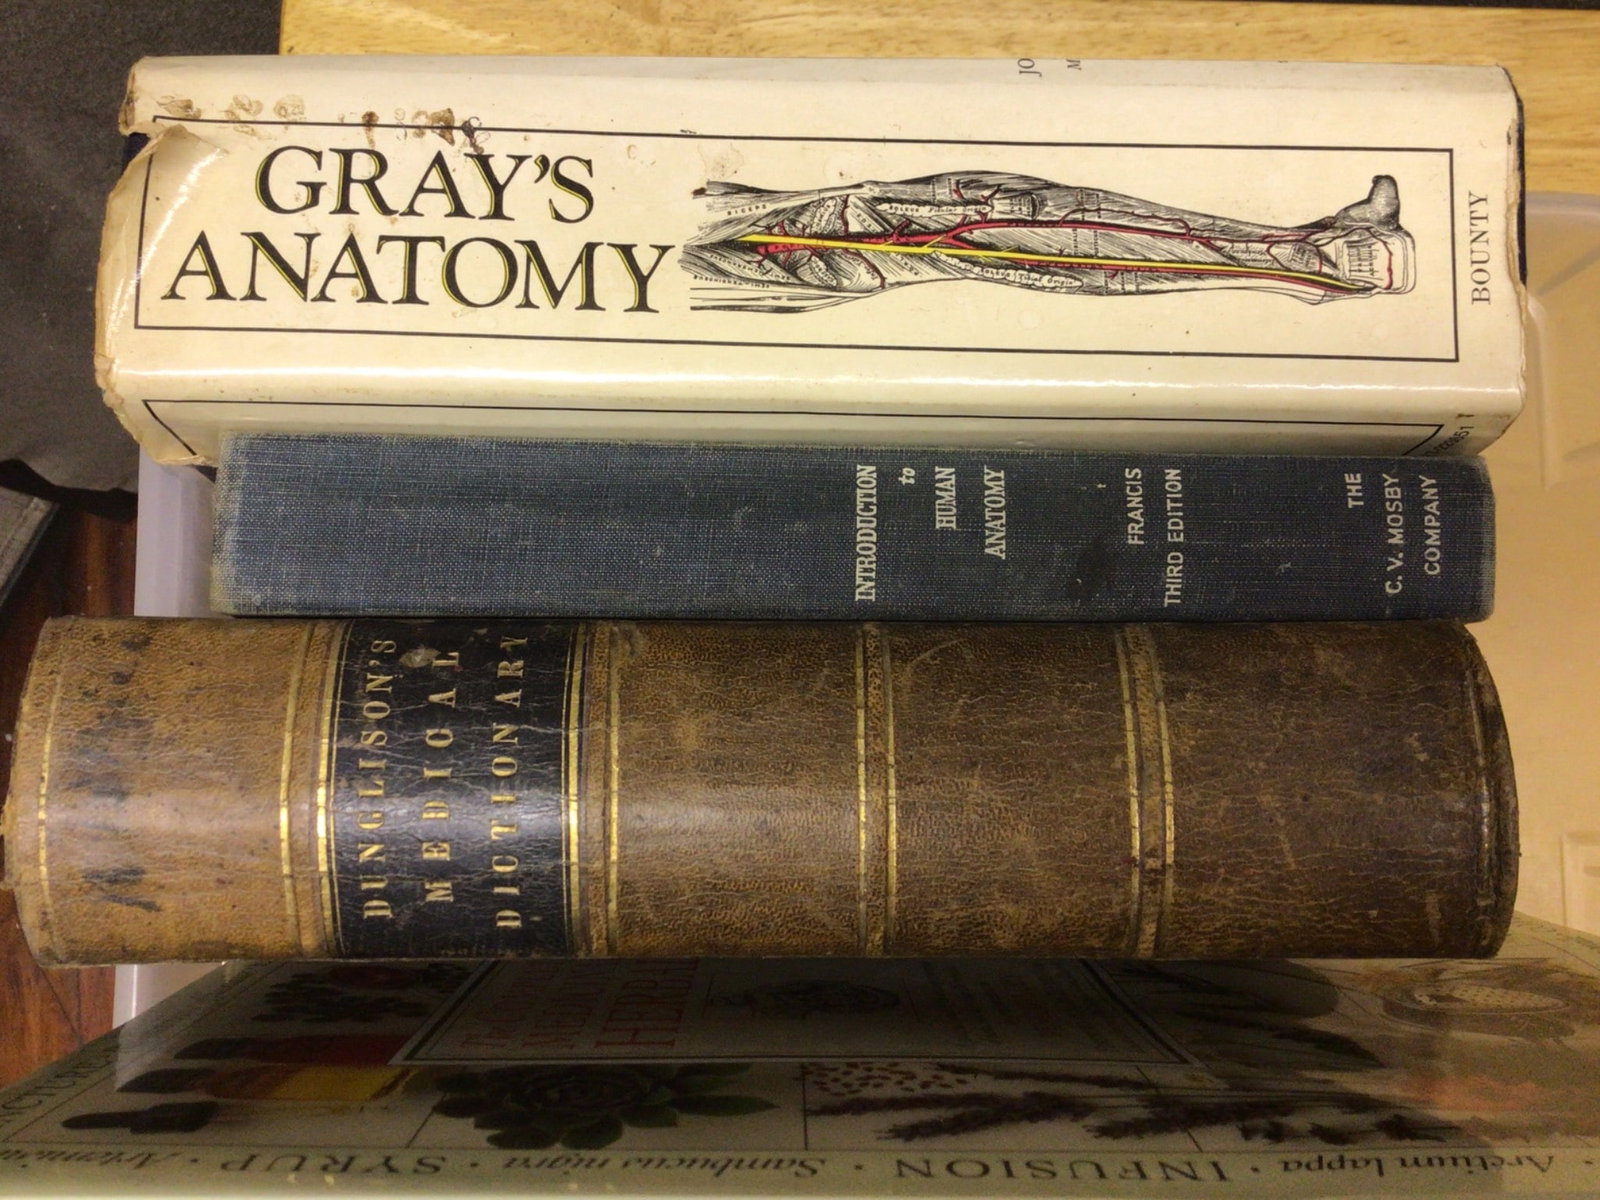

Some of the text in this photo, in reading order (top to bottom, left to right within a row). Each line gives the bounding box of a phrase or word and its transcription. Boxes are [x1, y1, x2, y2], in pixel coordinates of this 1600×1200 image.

[255, 145, 594, 223] GRAY'S
[727, 203, 767, 216] BICEPS
[160, 230, 675, 313] ANATOMY
[1469, 190, 1491, 305] BOUNTY
[898, 467, 916, 486] to
[935, 466, 957, 530] HUMAN
[984, 464, 1006, 560] ANATOMY
[1125, 468, 1145, 545] FRANCIS
[1344, 473, 1364, 508] THE
[1382, 473, 1404, 544] MOSBY
[855, 464, 878, 602] INTRODUCTION
[1164, 469, 1184, 607] THIRD EDITION
[1419, 475, 1441, 575] COMPANY
[358, 639, 397, 919] DUNGLISON'S
[422, 651, 460, 902] MEDICAL
[490, 636, 529, 928] DICTIONARY
[220, 1153, 447, 1175] SYRUP
[895, 1158, 1229, 1182] INFUSION
[1282, 1154, 1385, 1178] lappa
[1400, 1155, 1555, 1175] Arctium
